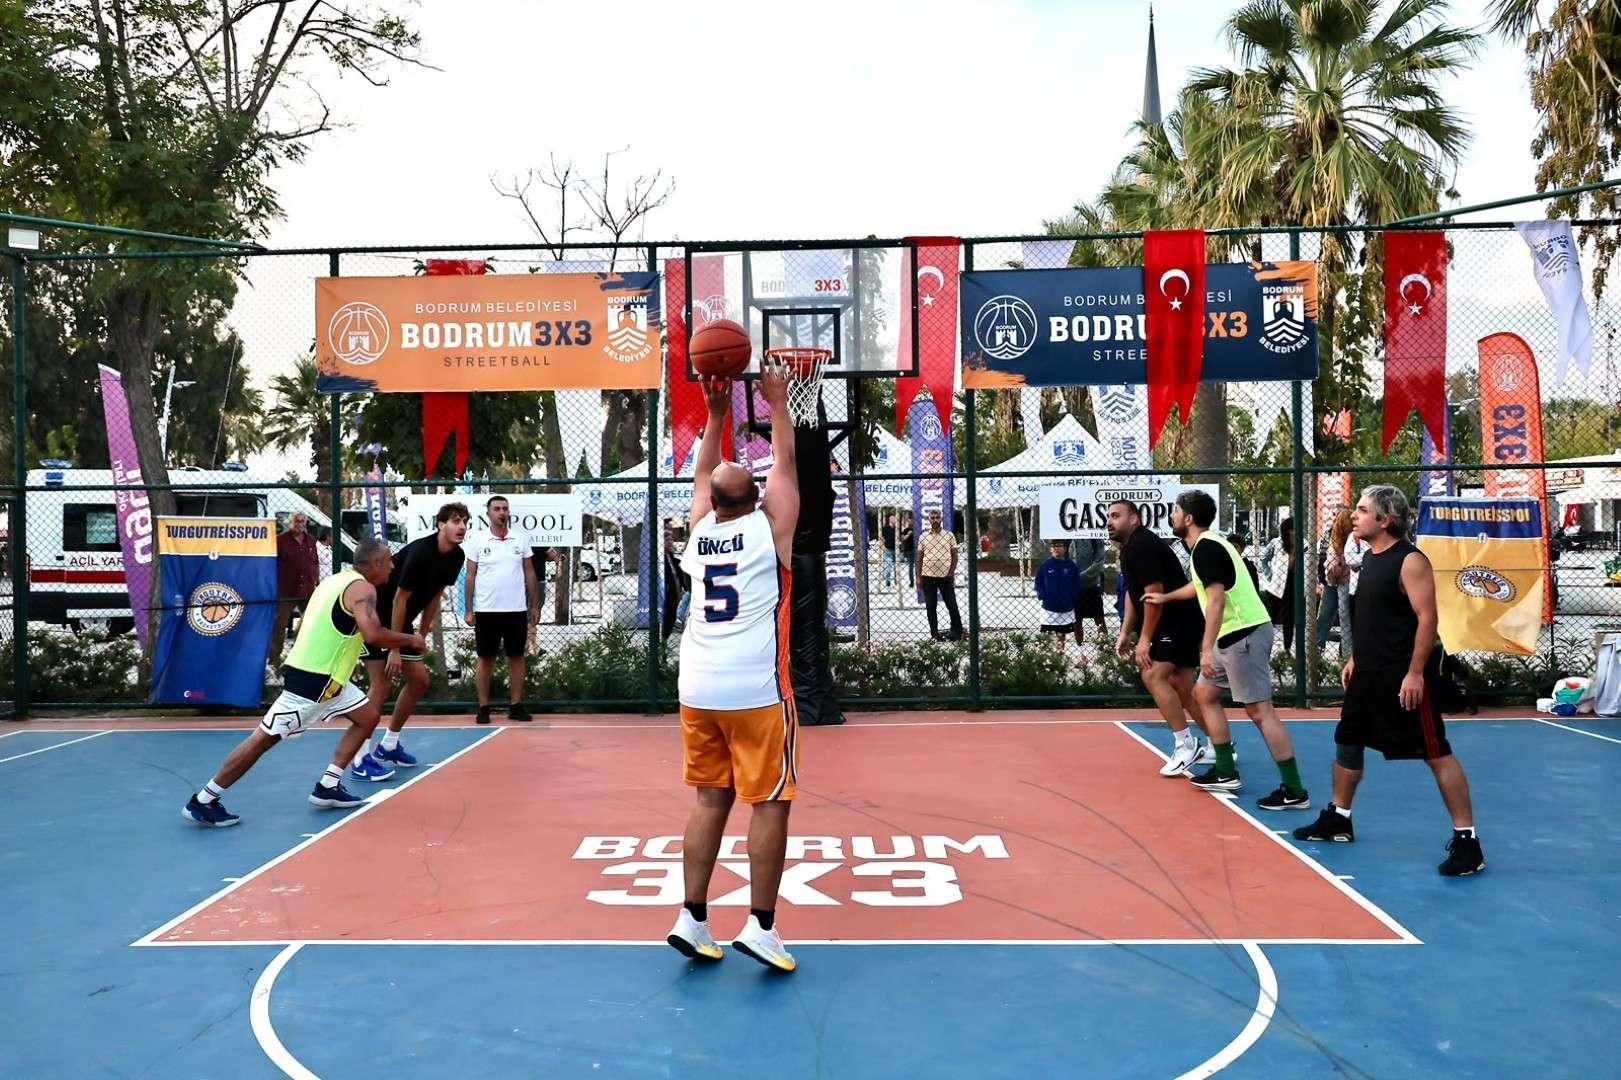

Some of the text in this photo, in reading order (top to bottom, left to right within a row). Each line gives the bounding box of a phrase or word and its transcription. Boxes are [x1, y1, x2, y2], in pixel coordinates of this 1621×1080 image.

[814, 280, 841, 292] 3X3
[1262, 286, 1304, 294] BODRUM
[415, 299, 577, 314] BODRUM BELEDİYESİ
[607, 296, 648, 304] BODRUM
[1064, 294, 1132, 307] BODRUM
[1259, 334, 1311, 354] BELEDİYESİ
[443, 355, 551, 367] STREETBALL
[1104, 490, 1154, 501] BODRUM
[508, 513, 573, 531] POOL
[698, 533, 744, 556] ÖNCÜ
[703, 563, 740, 623] 5
[585, 861, 964, 906] 3X3
